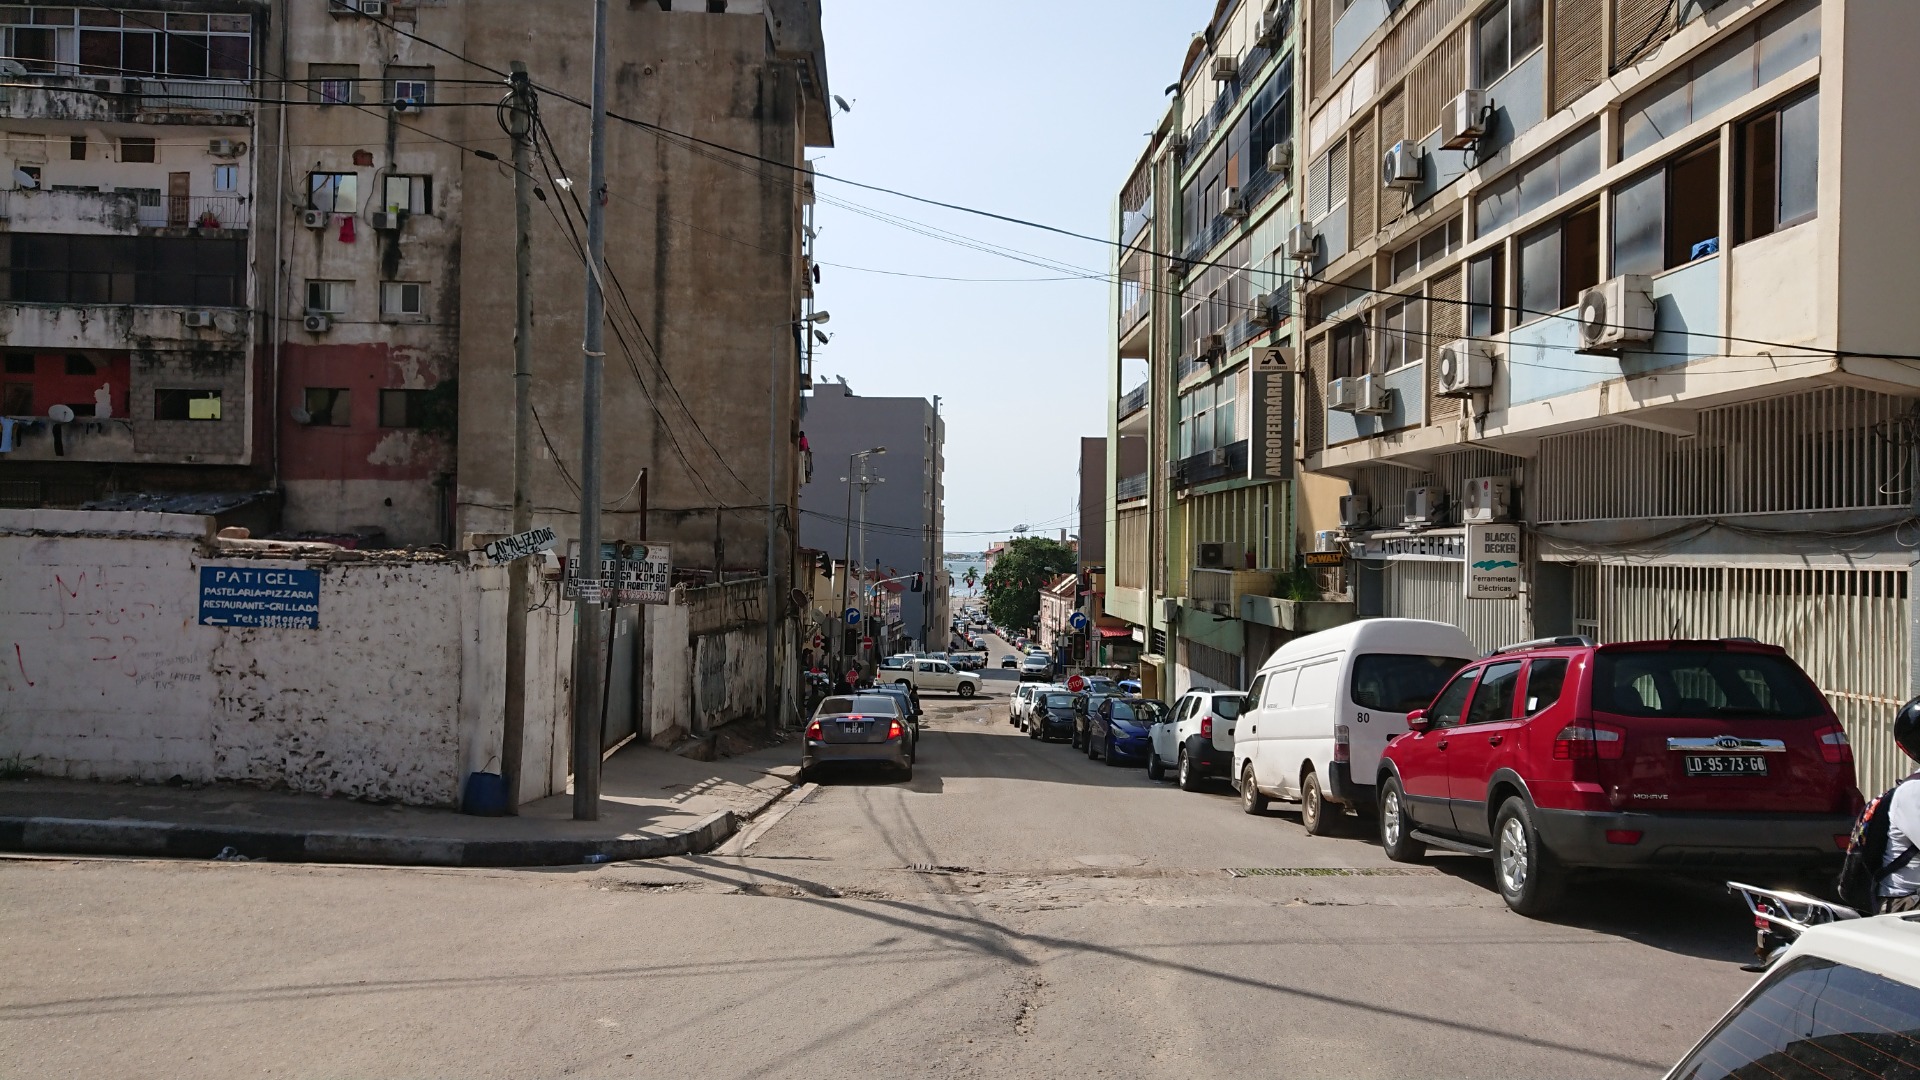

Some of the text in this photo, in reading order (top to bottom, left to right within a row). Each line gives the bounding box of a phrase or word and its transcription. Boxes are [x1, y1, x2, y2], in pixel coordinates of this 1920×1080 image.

[1263, 372, 1283, 477] ANGOFERRÁRIA
[1381, 536, 1465, 555] ANGOFERRAR
[658, 562, 669, 574] DE
[215, 571, 299, 586] PATIGEL
[635, 572, 666, 583] KOMBO
[1472, 574, 1517, 583] Ferramentas
[627, 581, 654, 592] ROBERT
[1477, 584, 1512, 592] Eléctricas
[204, 587, 314, 599] PASTELARIA-PIZZARIA
[1068, 680, 1083, 689] STOP
[1357, 712, 1370, 723] 80
[1721, 740, 1738, 748] KIA
